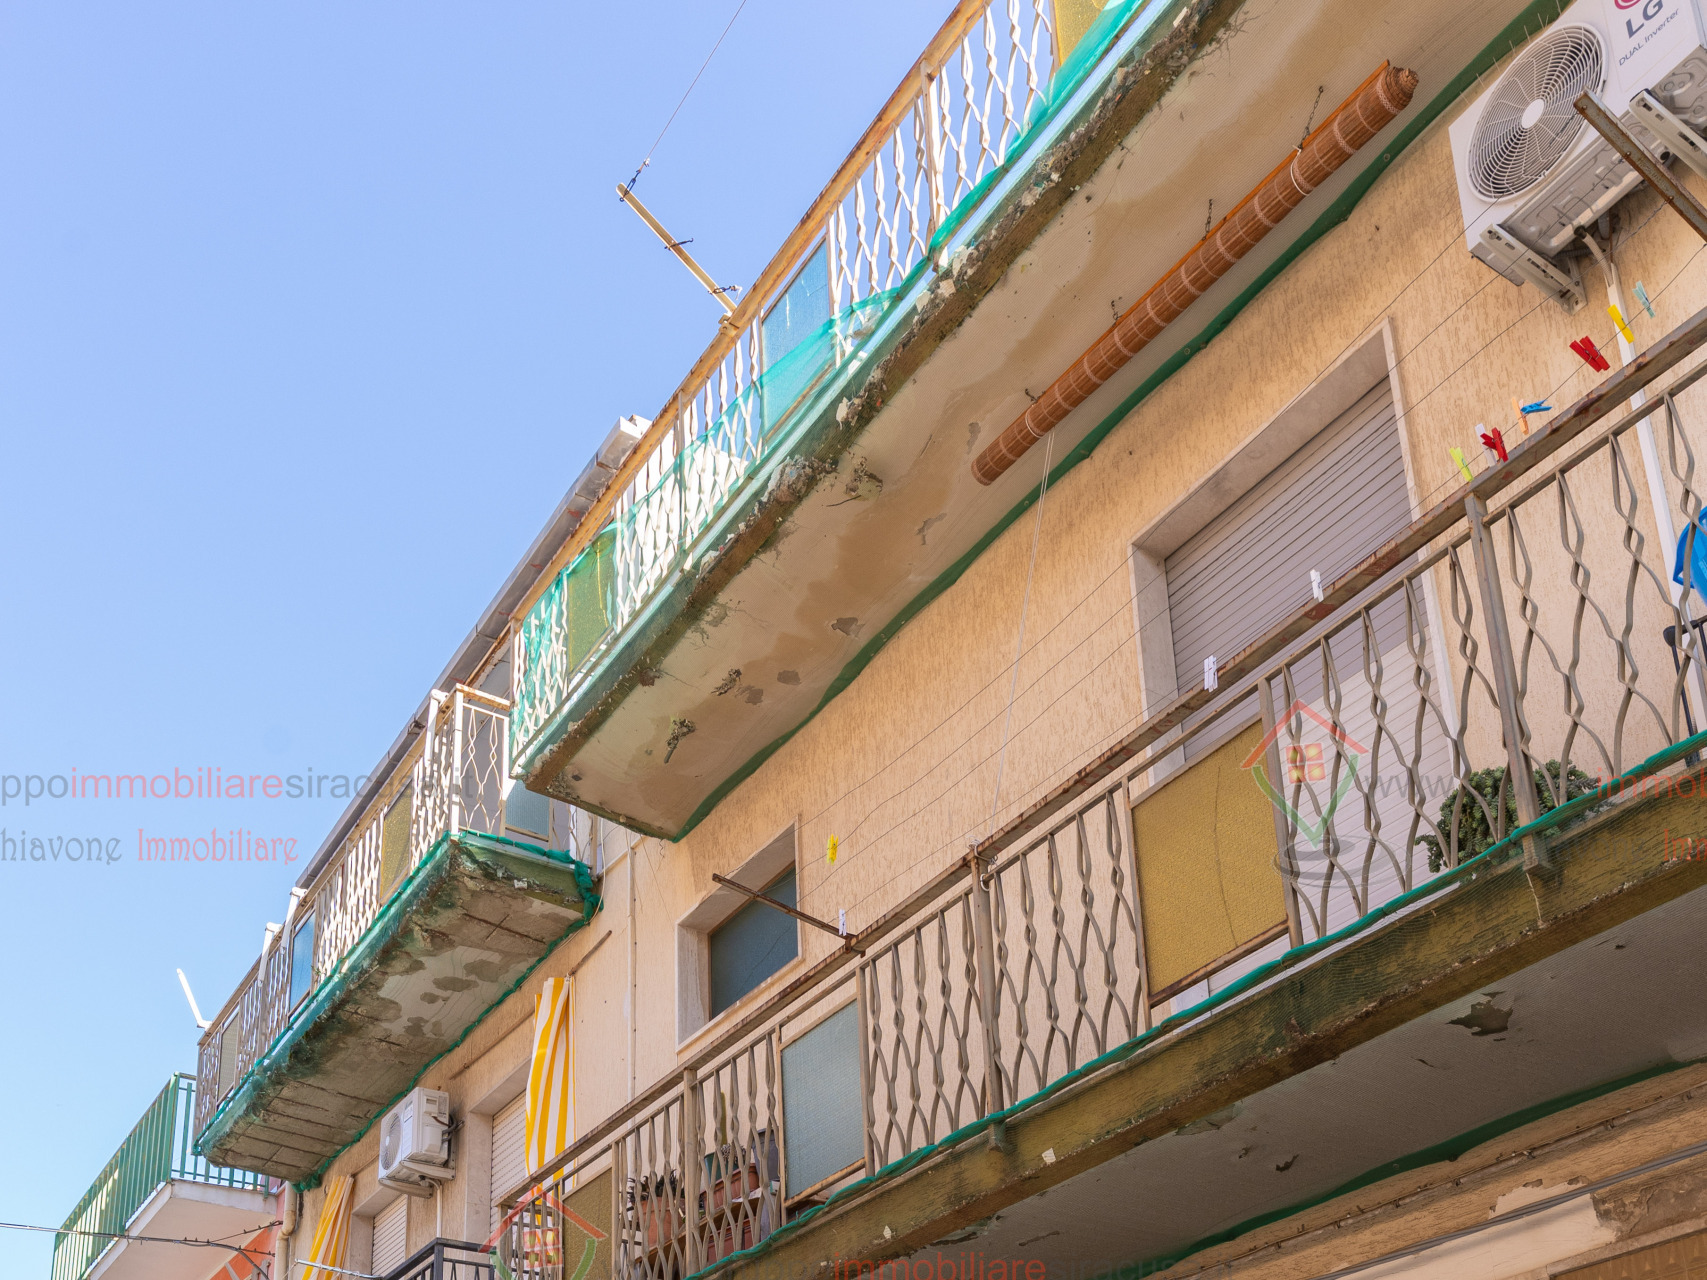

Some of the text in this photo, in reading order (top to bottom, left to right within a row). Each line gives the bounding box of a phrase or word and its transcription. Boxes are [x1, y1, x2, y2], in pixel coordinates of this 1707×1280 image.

[1618, 8, 1679, 67] DUAL Inverter
[1625, 0, 1664, 40] LG
